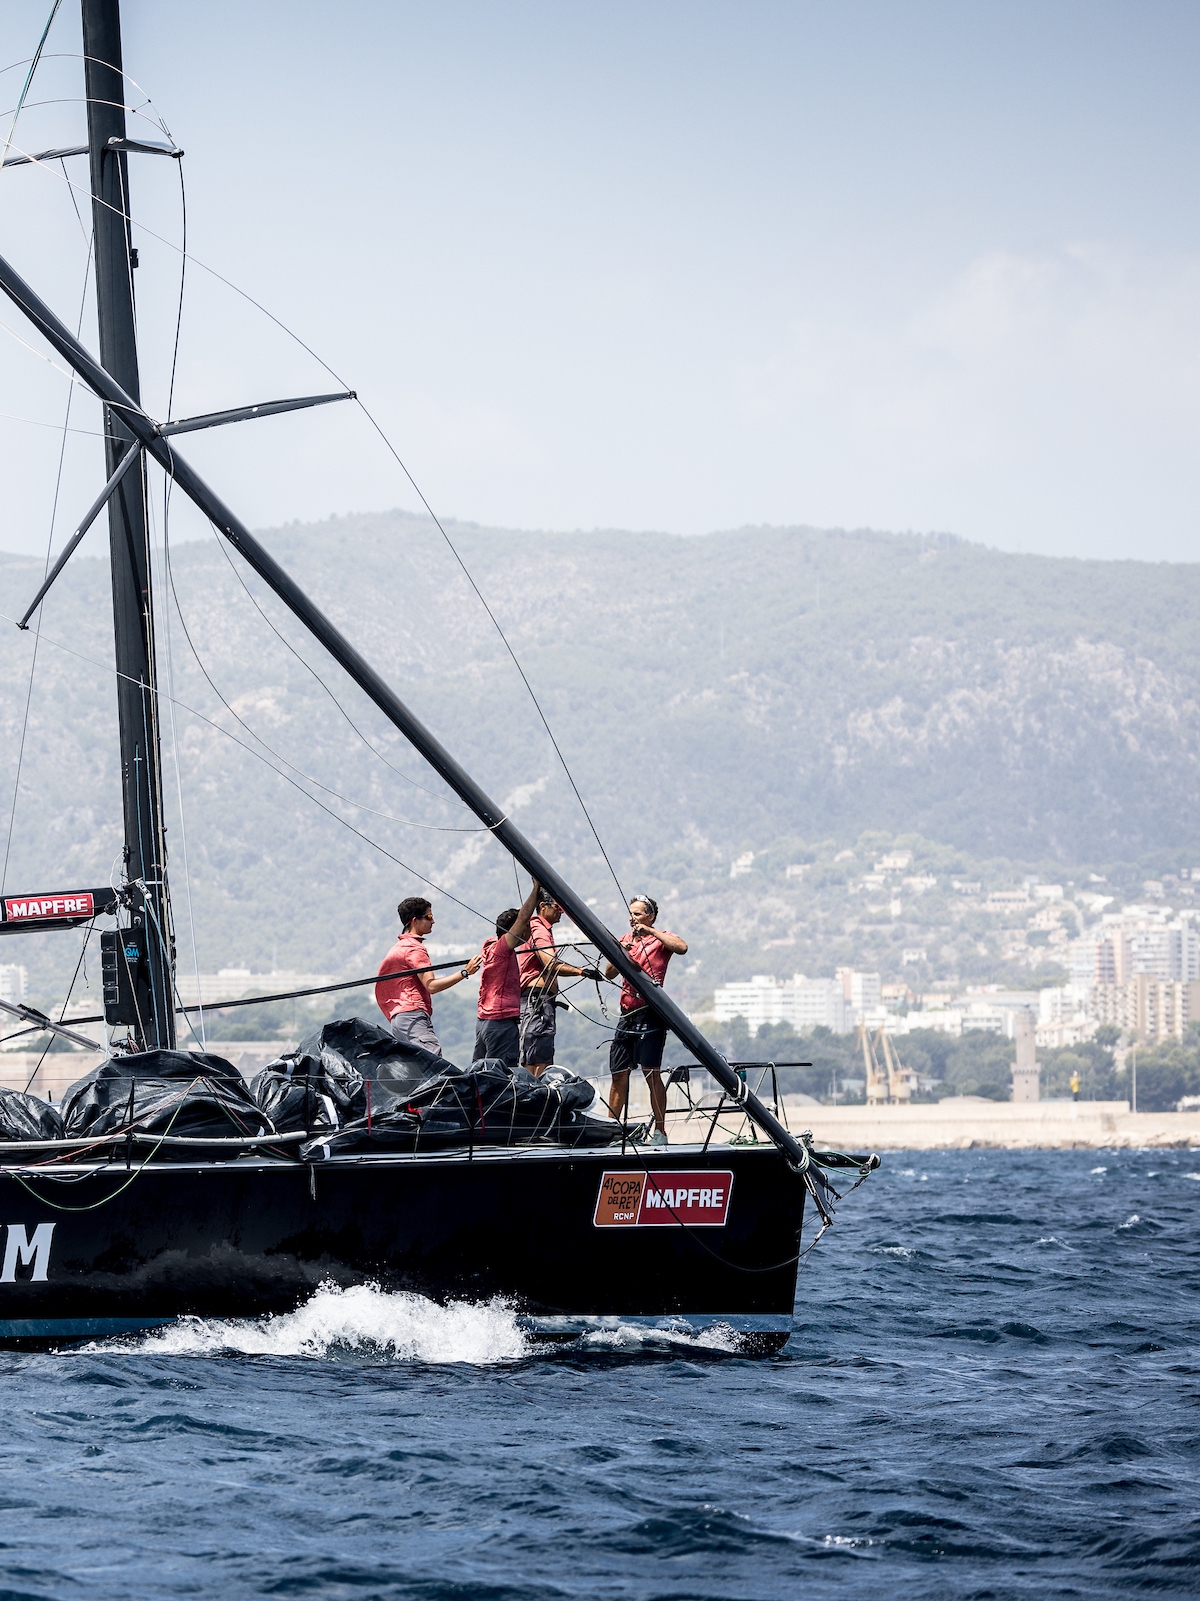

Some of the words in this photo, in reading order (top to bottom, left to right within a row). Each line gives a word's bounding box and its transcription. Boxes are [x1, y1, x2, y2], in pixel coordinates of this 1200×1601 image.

[13, 897, 88, 917] MAPFRE
[603, 1177, 614, 1190] 41
[612, 1181, 641, 1195] COPA
[607, 1196, 619, 1205] DEL
[618, 1195, 640, 1210] REY
[646, 1188, 725, 1208] MAPFRE
[613, 1212, 635, 1220] RCNP
